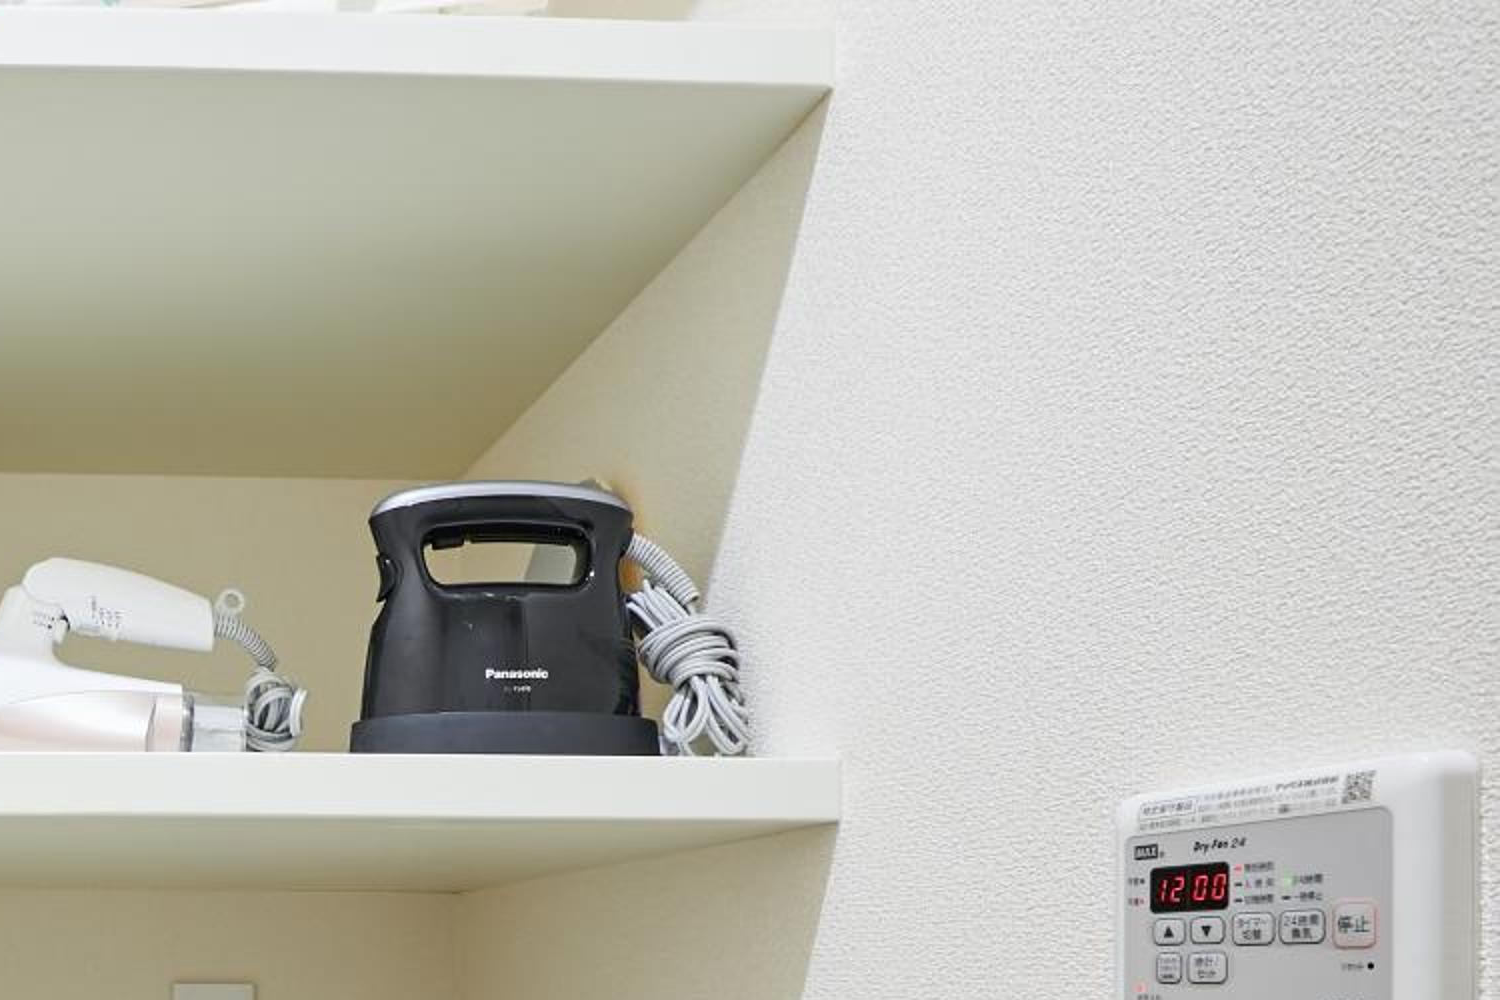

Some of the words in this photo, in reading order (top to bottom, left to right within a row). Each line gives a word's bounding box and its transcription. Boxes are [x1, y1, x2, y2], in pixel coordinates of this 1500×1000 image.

[484, 667, 549, 680] Panasonic
[1135, 845, 1158, 860] MAX
[1338, 915, 1372, 934] 停止
